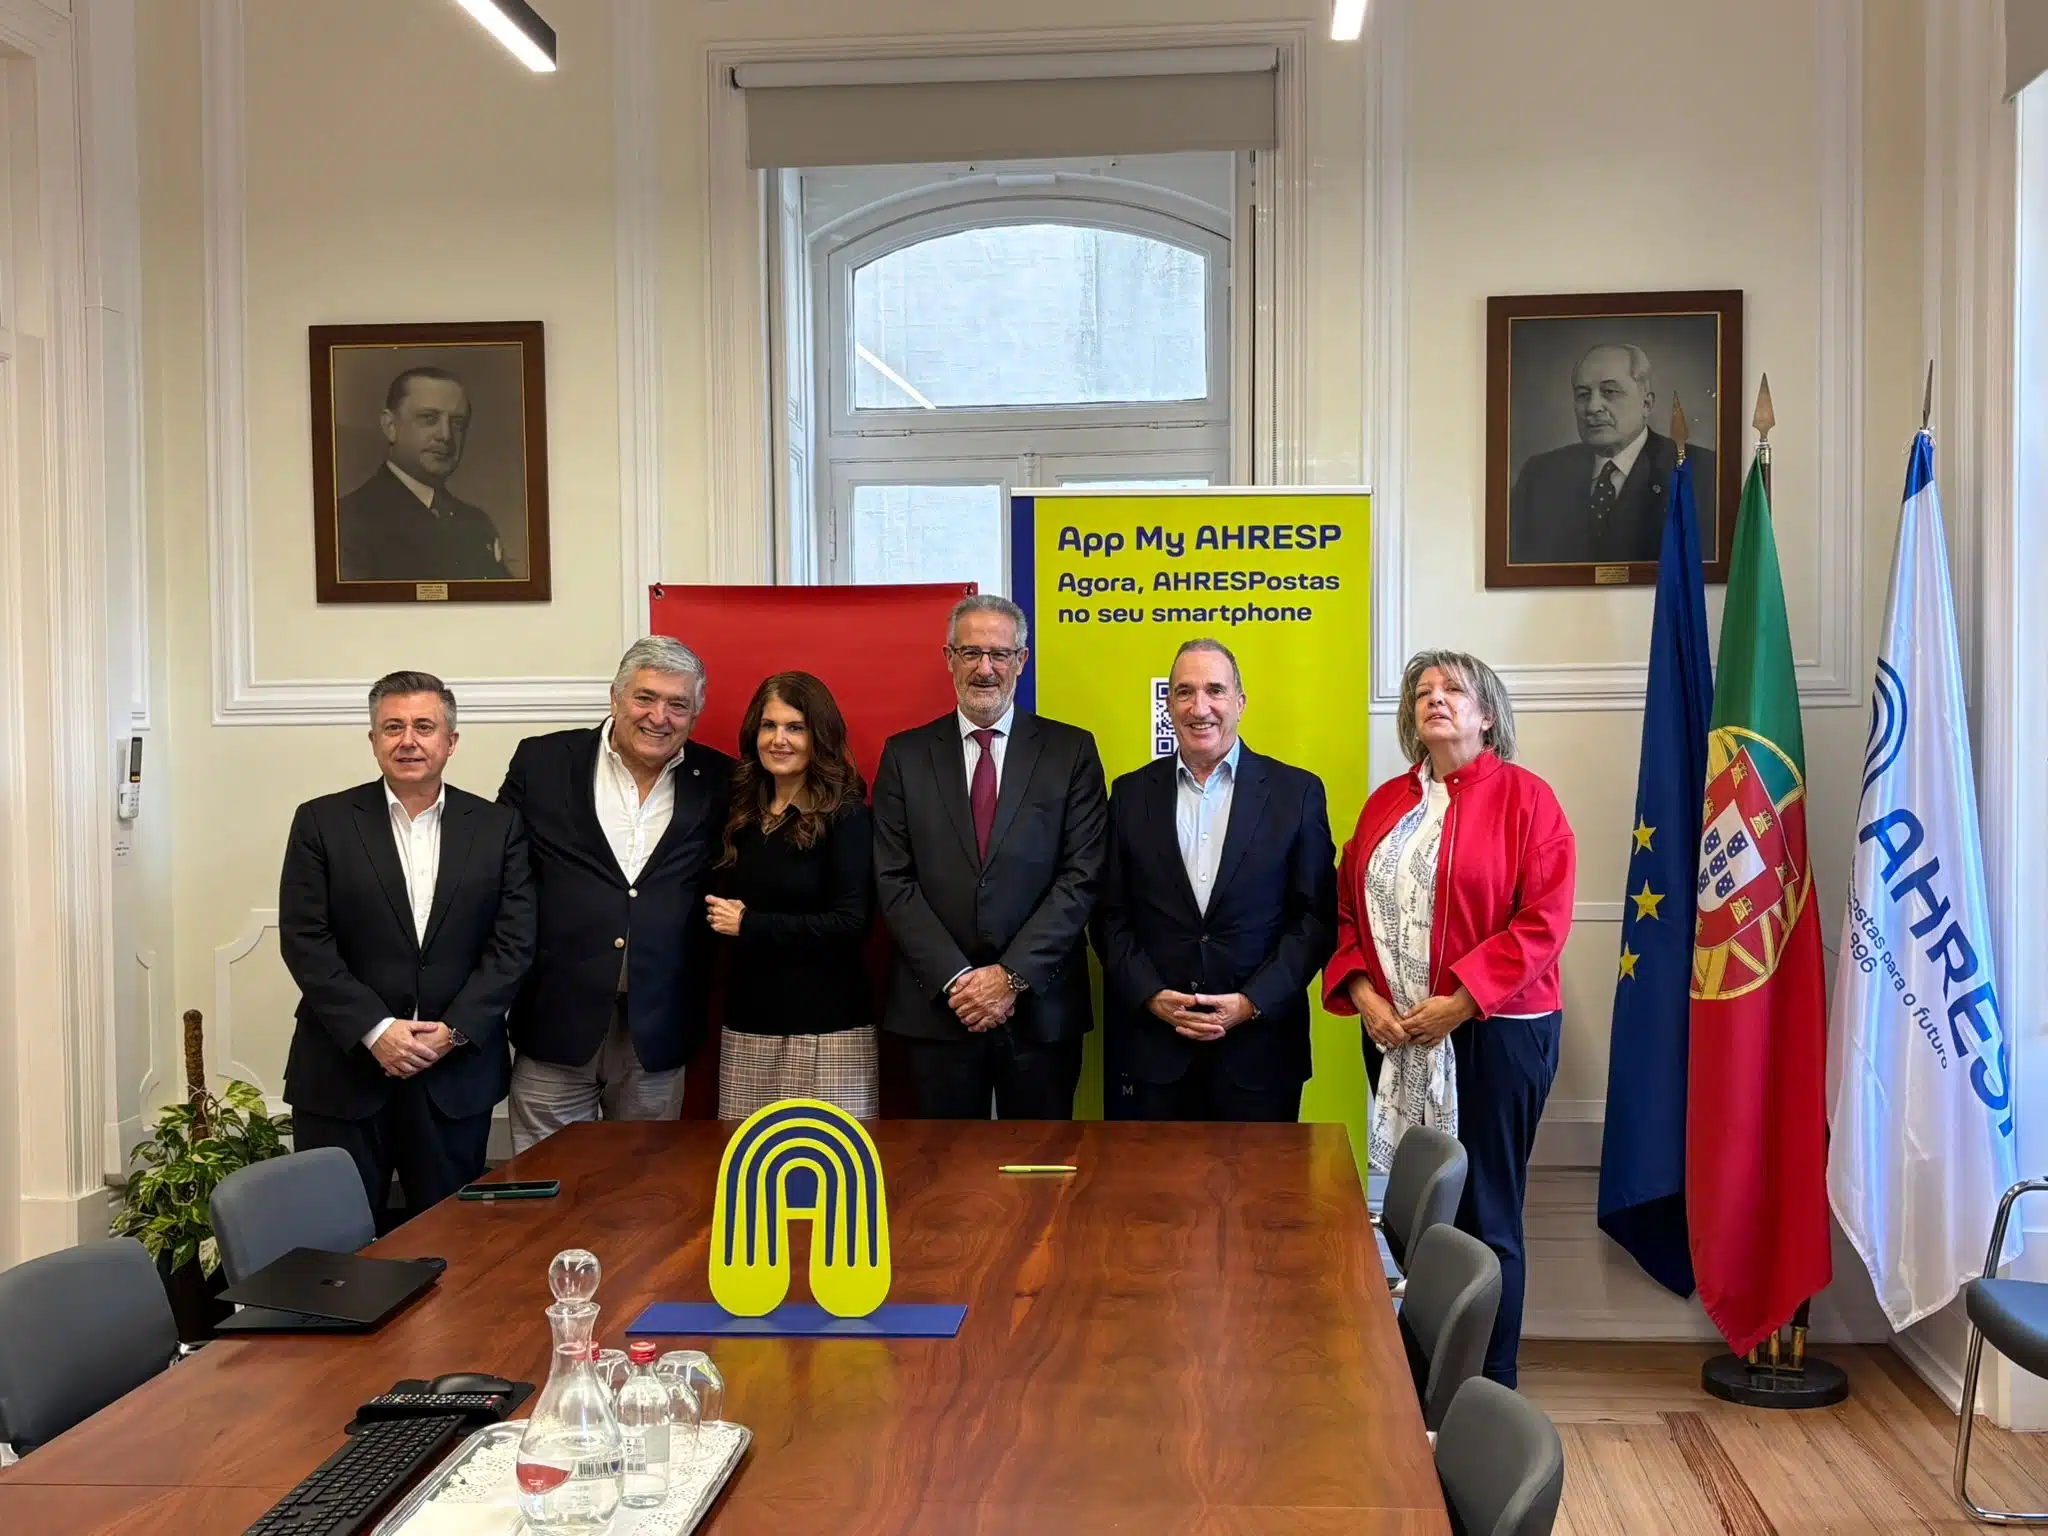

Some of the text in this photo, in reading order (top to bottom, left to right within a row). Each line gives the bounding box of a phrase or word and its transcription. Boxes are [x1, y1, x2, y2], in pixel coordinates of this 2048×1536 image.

[1057, 524, 1342, 558] App My AHRESP
[1057, 571, 1340, 598] Agora, AHRESPostas
[1058, 602, 1313, 627] no seu smartphone
[1850, 923, 1877, 973] 896
[1858, 808, 2014, 1138] AHRES
[1880, 951, 1906, 992] para
[1903, 993, 1916, 1006] o
[1912, 1006, 1948, 1070] futuro
